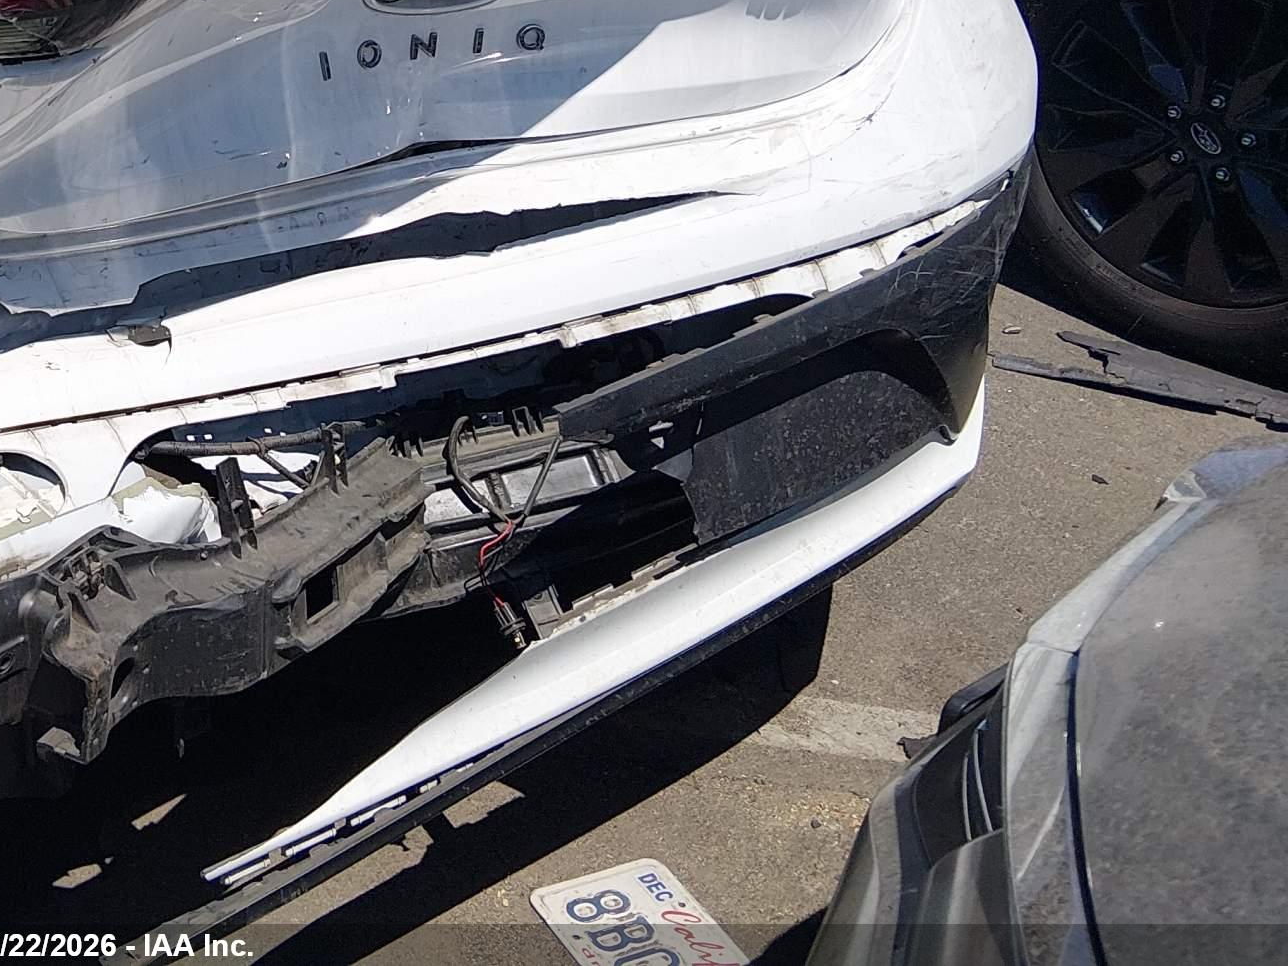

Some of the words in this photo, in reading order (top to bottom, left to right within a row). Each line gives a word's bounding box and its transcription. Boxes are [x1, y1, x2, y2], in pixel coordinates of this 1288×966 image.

[318, 23, 546, 82] IONIQ
[638, 872, 673, 902] DEC
[661, 910, 741, 966] Cali
